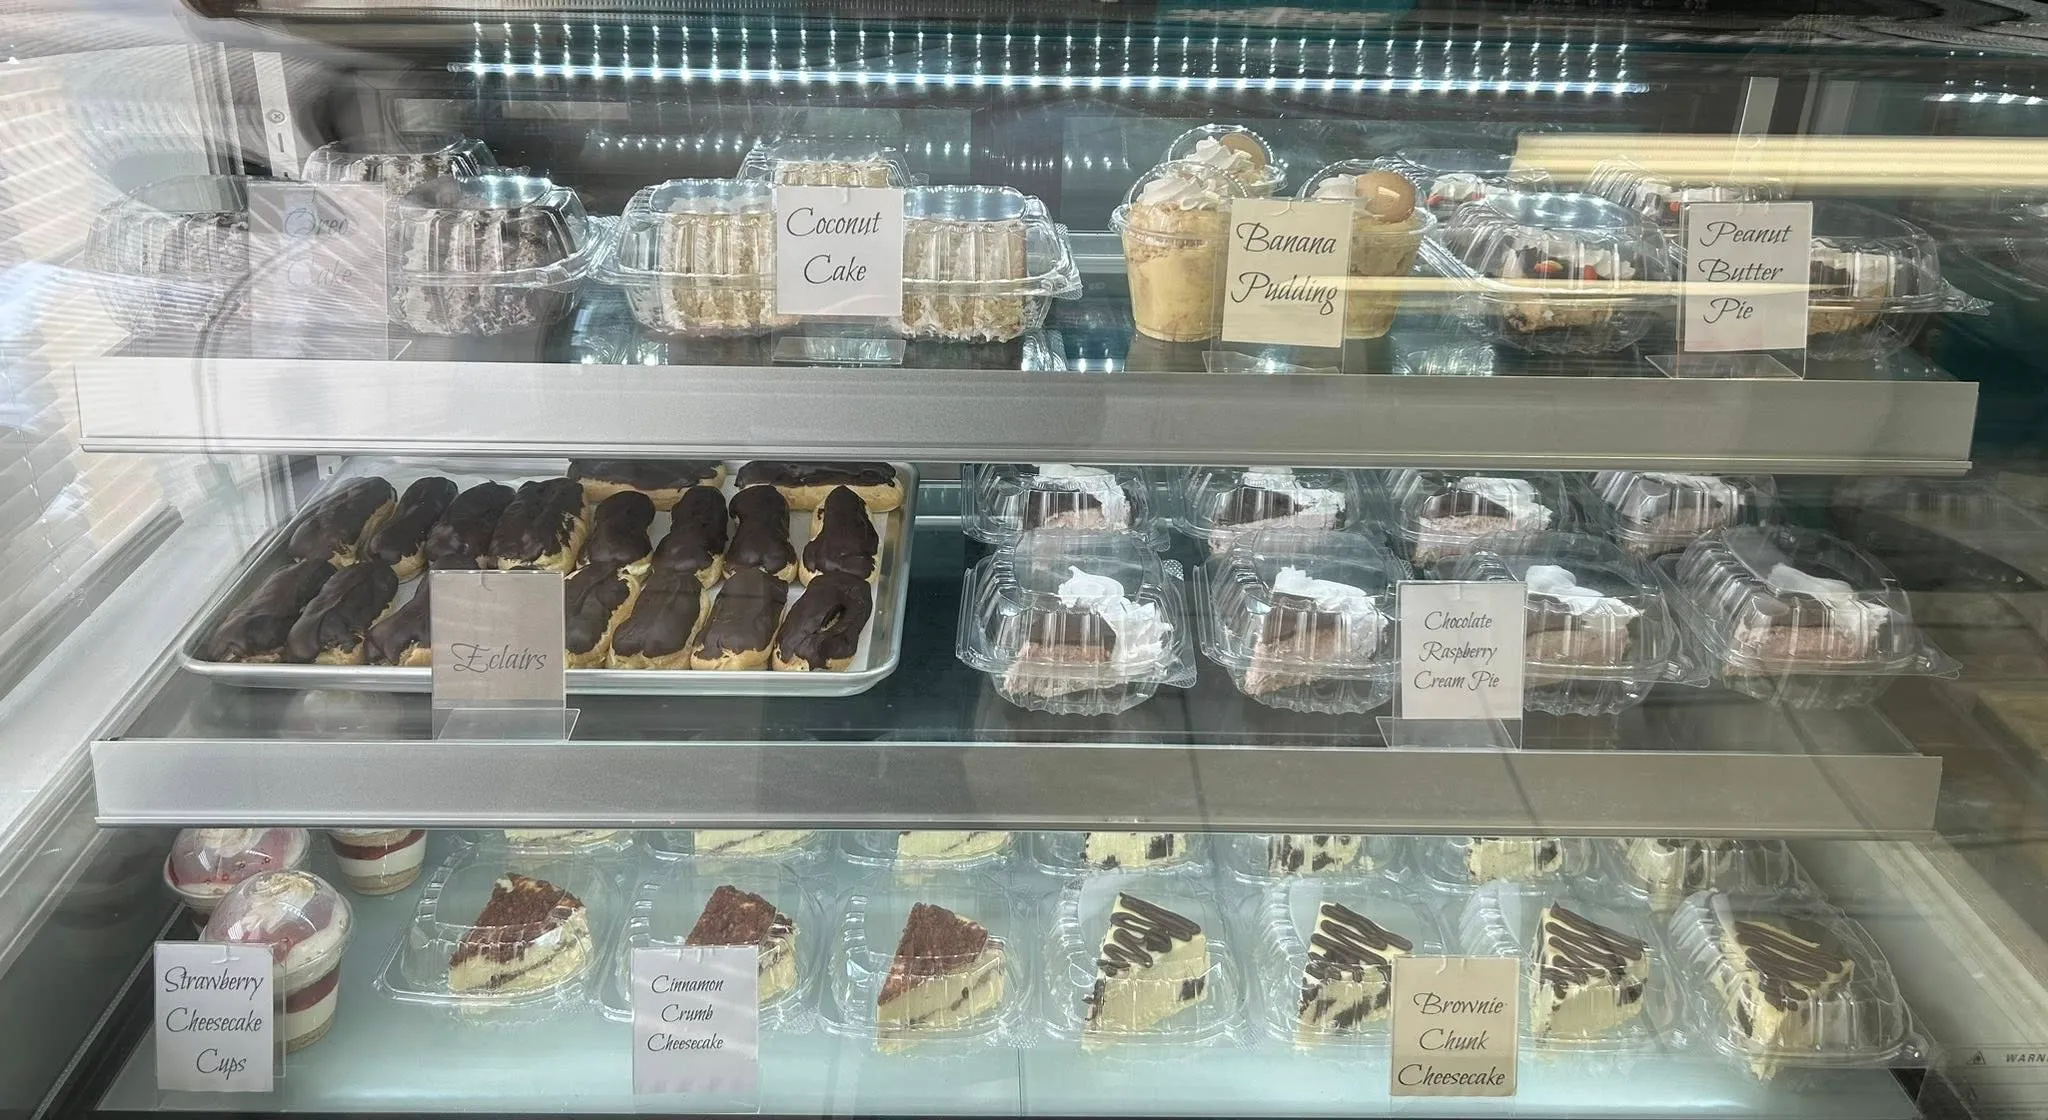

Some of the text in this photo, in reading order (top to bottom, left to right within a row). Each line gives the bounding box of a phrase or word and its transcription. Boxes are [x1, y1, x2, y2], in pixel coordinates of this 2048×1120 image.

[284, 207, 349, 236] Oreo
[786, 207, 882, 237] Coconut
[1699, 221, 1792, 247] Peanut
[1236, 222, 1337, 254] Banana
[287, 257, 352, 286] Cake
[804, 254, 867, 284] Cake
[1698, 258, 1783, 282] Butter
[1231, 271, 1338, 315] Pudding
[1703, 297, 1754, 324] Pie
[1424, 611, 1492, 630] Chocolate
[450, 642, 547, 673] Eclairs
[1418, 641, 1498, 665] Raspberry
[1414, 670, 1500, 691] Cream Pie
[164, 966, 264, 1000] Strawberry
[651, 974, 724, 993] Cinnamon
[661, 1003, 713, 1022] Crumb
[1413, 992, 1504, 1015] Brownie
[166, 1007, 262, 1032] Cheesecake
[647, 1033, 724, 1052] Cheesecake
[1419, 1028, 1489, 1051] Chunk
[196, 1048, 247, 1080] Cups
[1398, 1063, 1506, 1086] Cheesecake
